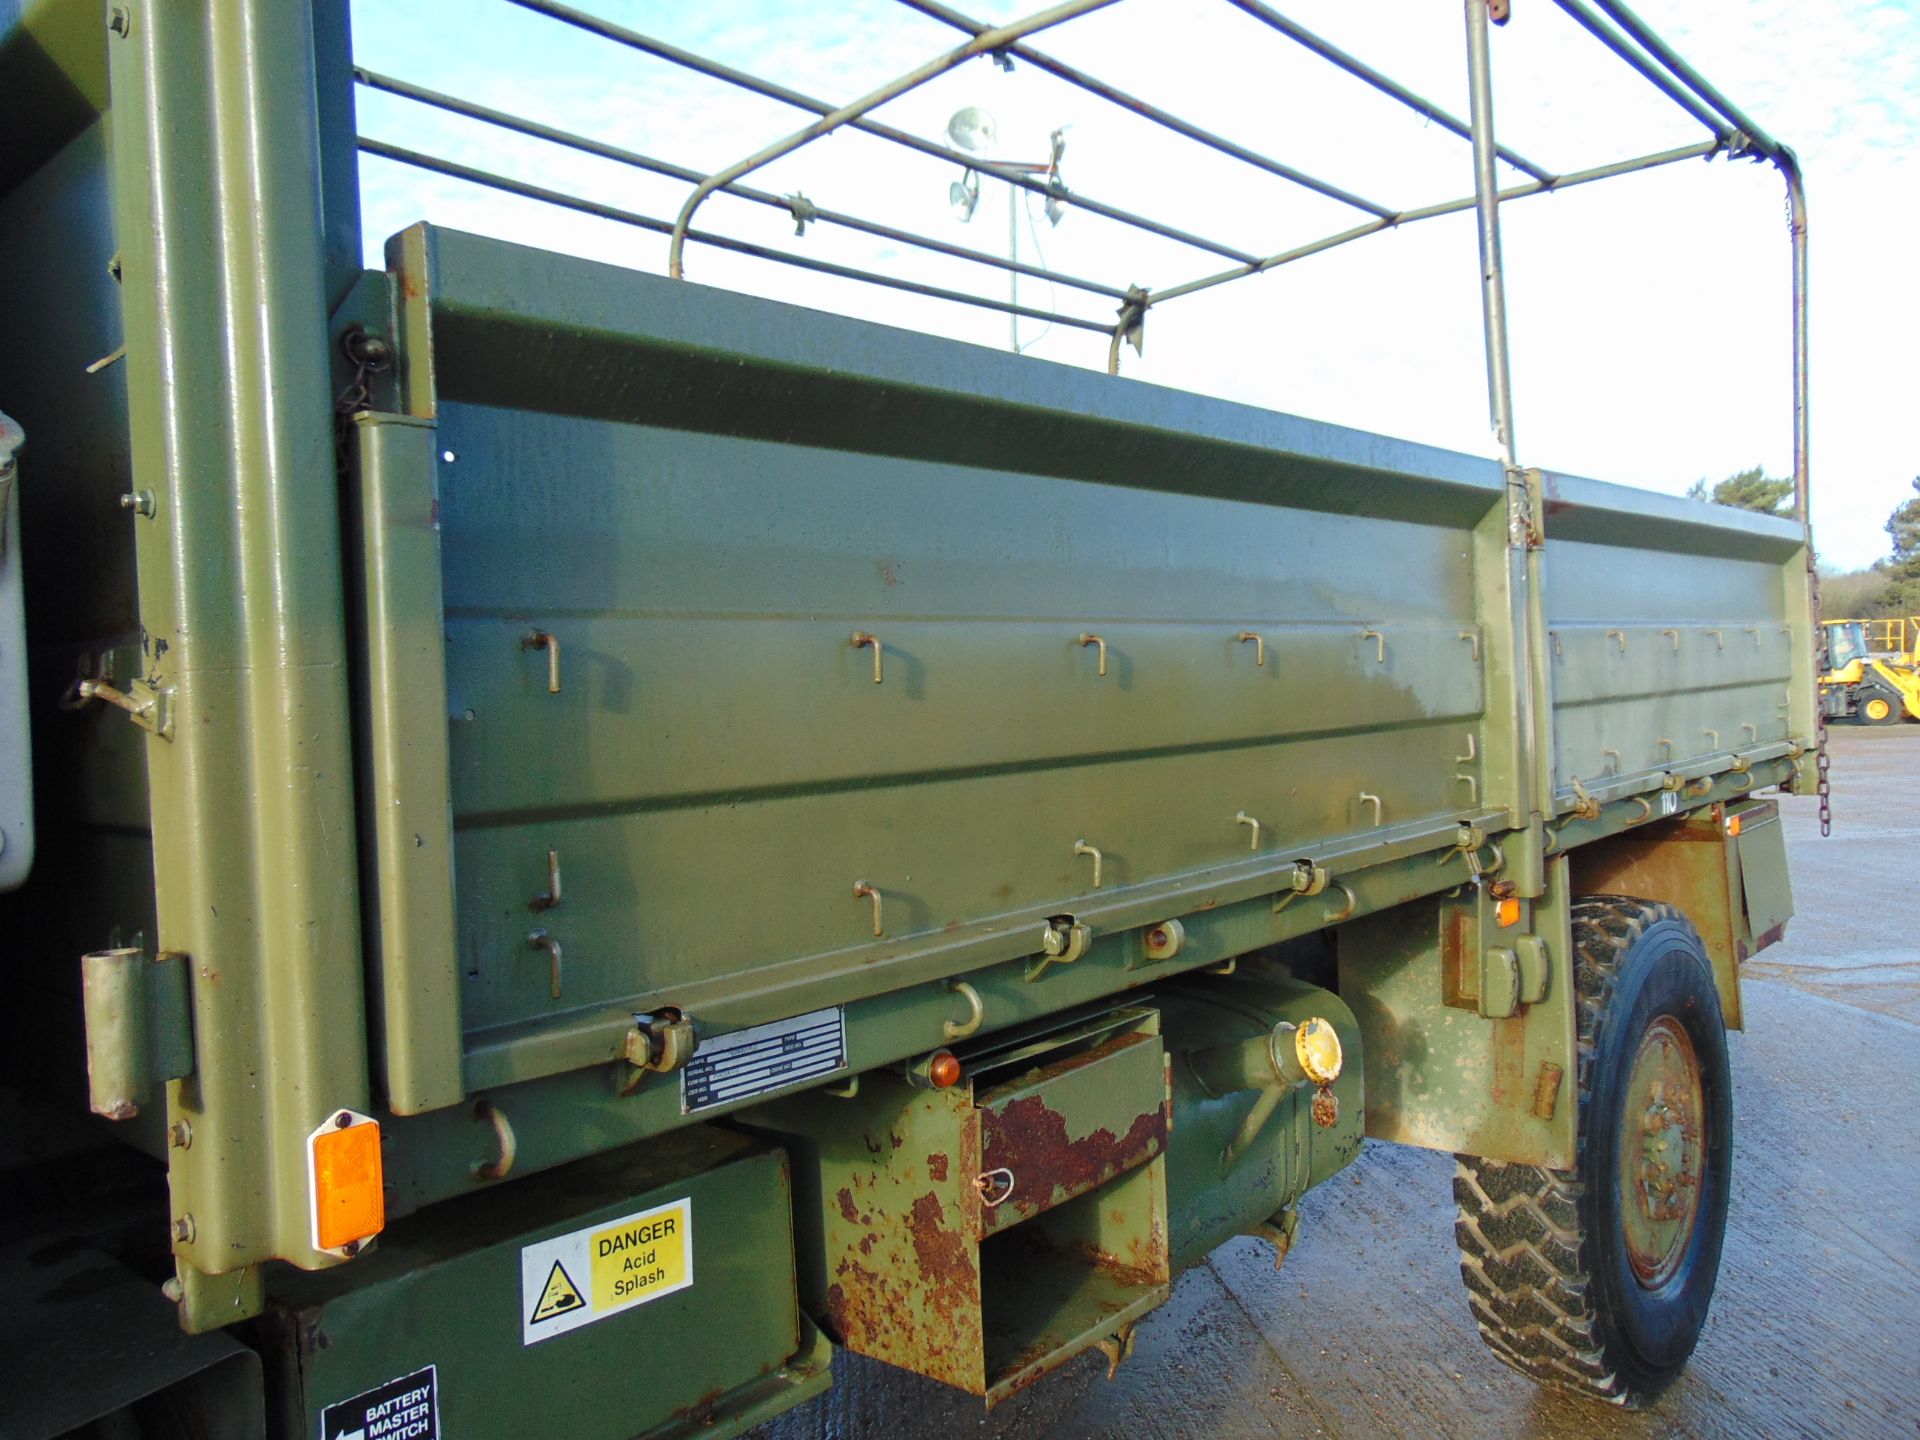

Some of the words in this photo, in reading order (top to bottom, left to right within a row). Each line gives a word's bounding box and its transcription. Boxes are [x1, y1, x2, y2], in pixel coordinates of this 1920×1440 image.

[1661, 791, 1677, 815] 110
[599, 1218, 676, 1258] DANGER
[623, 1249, 657, 1273] Acid
[614, 1268, 665, 1297] Splash
[366, 1385, 431, 1422] BATTERY
[369, 1402, 429, 1438] MASTER
[374, 1419, 429, 1440] WITCH
